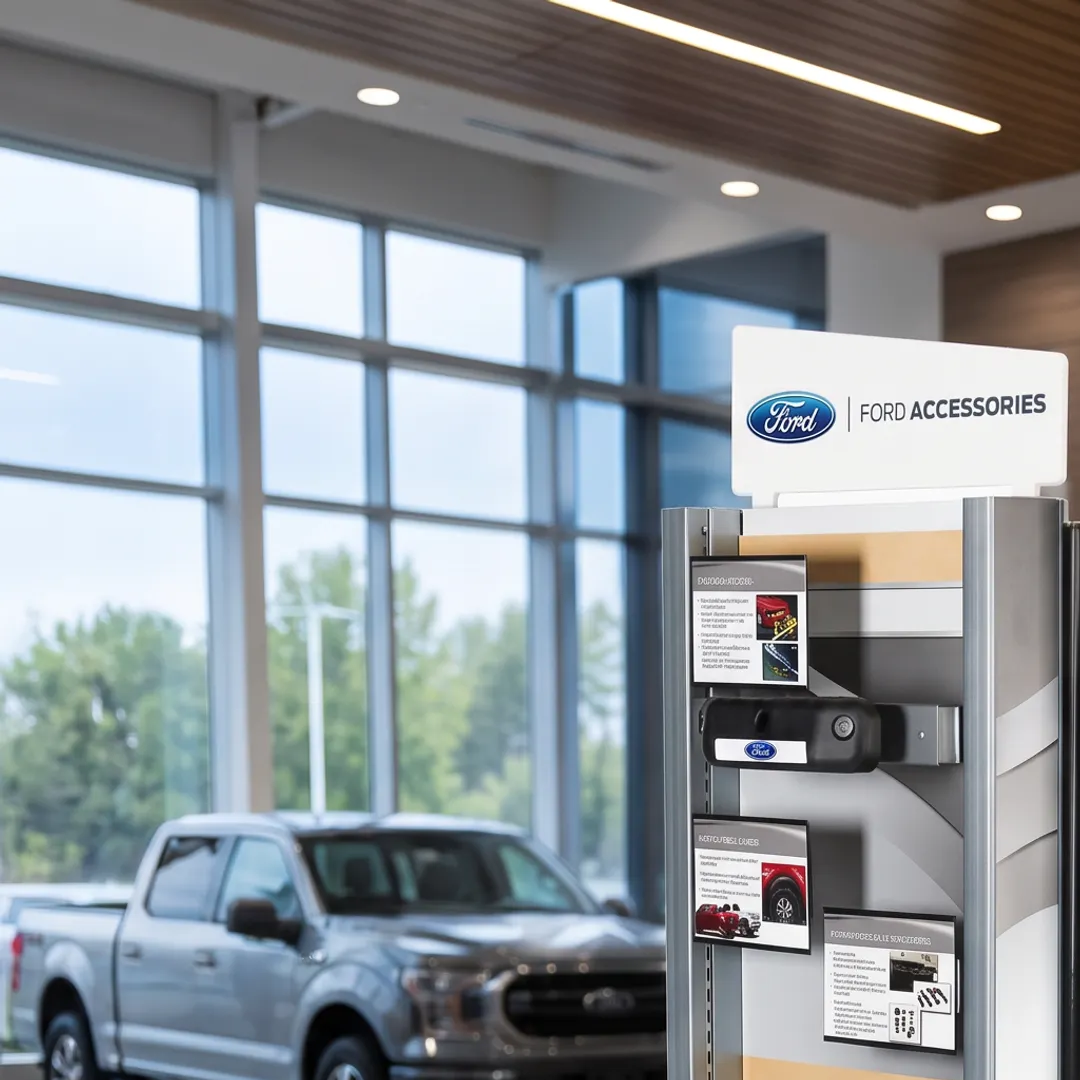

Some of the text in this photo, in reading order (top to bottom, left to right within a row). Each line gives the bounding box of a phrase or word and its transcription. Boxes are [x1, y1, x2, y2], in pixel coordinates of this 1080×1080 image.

[763, 401, 819, 434] Ford
[860, 393, 1047, 423] FORD ACCESSORIES
